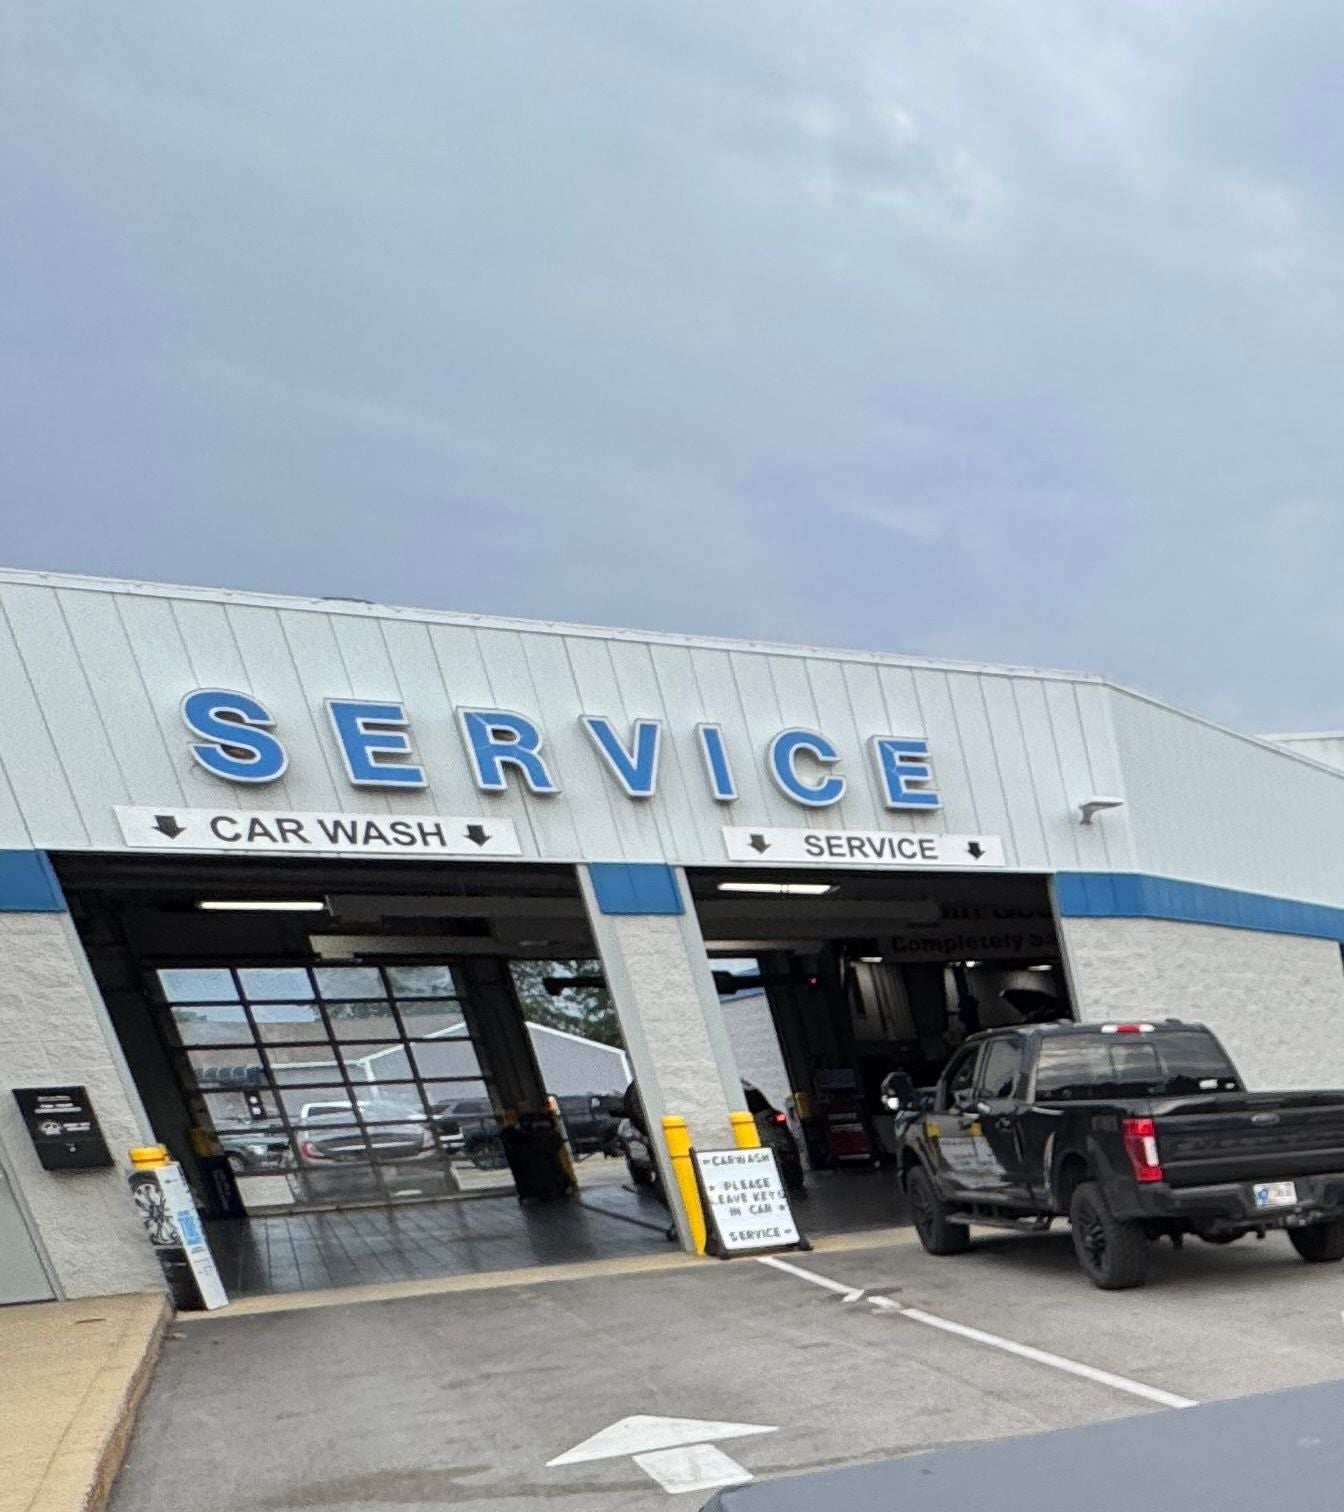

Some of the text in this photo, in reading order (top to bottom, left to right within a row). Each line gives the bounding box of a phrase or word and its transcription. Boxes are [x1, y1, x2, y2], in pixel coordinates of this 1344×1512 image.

[180, 687, 944, 811] SERVICE
[210, 814, 448, 849] CAR WASH
[803, 833, 940, 862] SERVICE
[724, 1178, 769, 1190] PLEASE
[708, 1192, 748, 1205] EAVE
[729, 1227, 780, 1242] SERVICE
